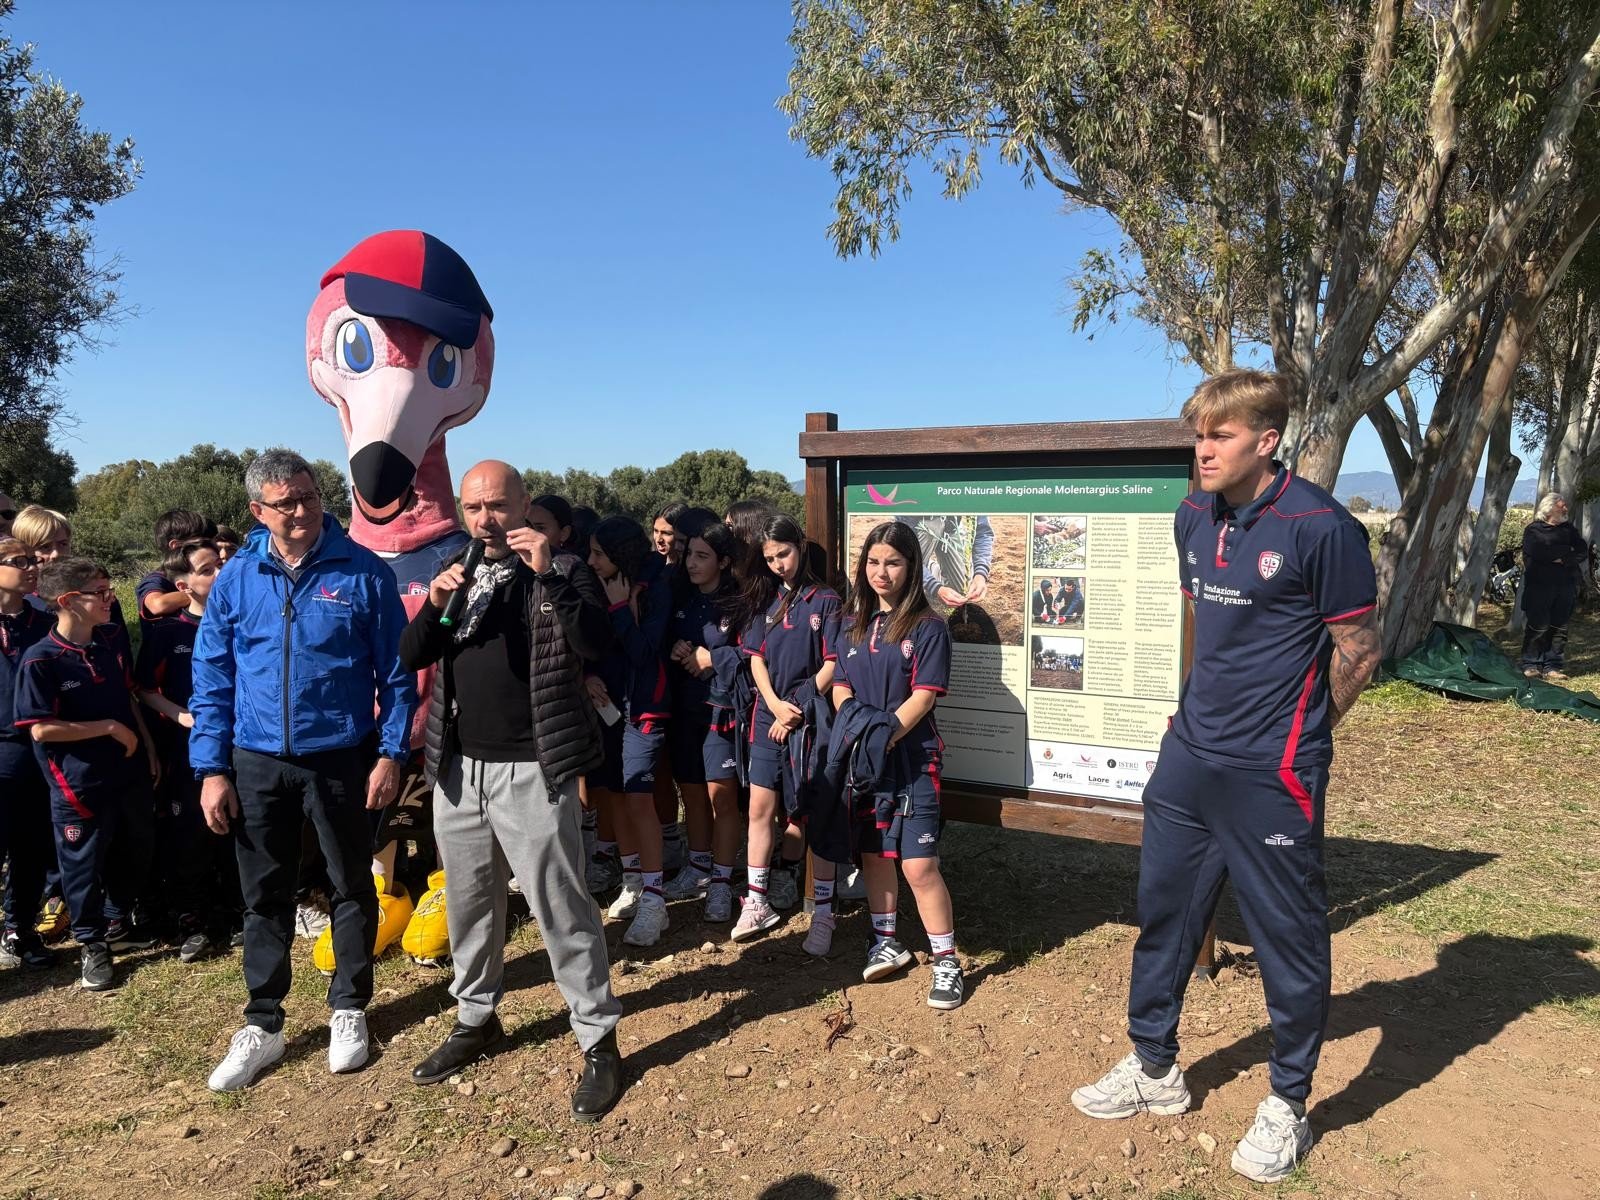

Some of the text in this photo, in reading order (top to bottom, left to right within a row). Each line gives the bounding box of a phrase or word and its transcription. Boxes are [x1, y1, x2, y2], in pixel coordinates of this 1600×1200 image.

[937, 484, 1153, 497] Parco Naturale Regionale Molentargius Saline
[1203, 582, 1241, 597] fondazione
[1223, 596, 1253, 606] prama
[1053, 771, 1073, 780] Agris
[1088, 775, 1110, 784] Laore
